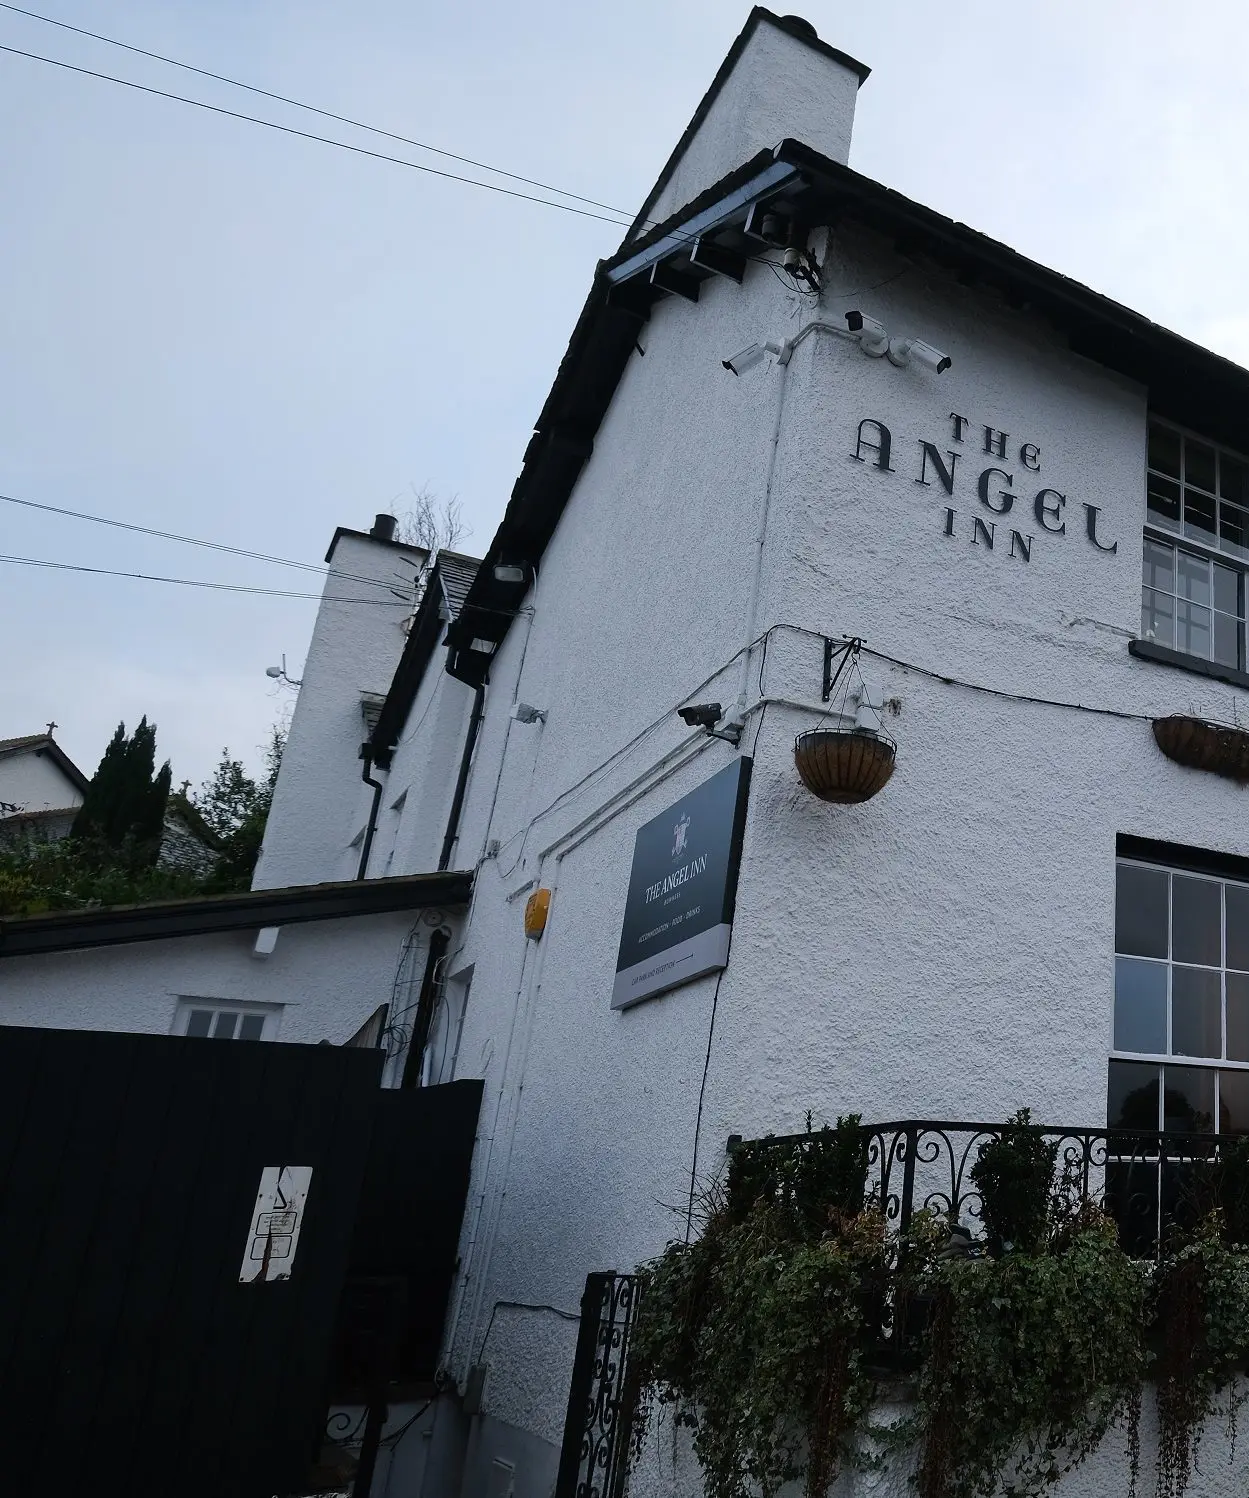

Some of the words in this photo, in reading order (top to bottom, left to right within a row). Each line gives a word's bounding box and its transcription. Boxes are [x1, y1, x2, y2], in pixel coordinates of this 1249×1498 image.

[949, 412, 1041, 472] THE
[849, 418, 1118, 555] ANGEL
[942, 507, 1034, 563] INN
[645, 881, 662, 904] THE
[661, 866, 689, 894] ANGEL
[690, 854, 708, 879] INN
[638, 922, 669, 943] ACCOMMODATION
[671, 915, 683, 927] FOOD
[685, 905, 701, 919] DRINKS
